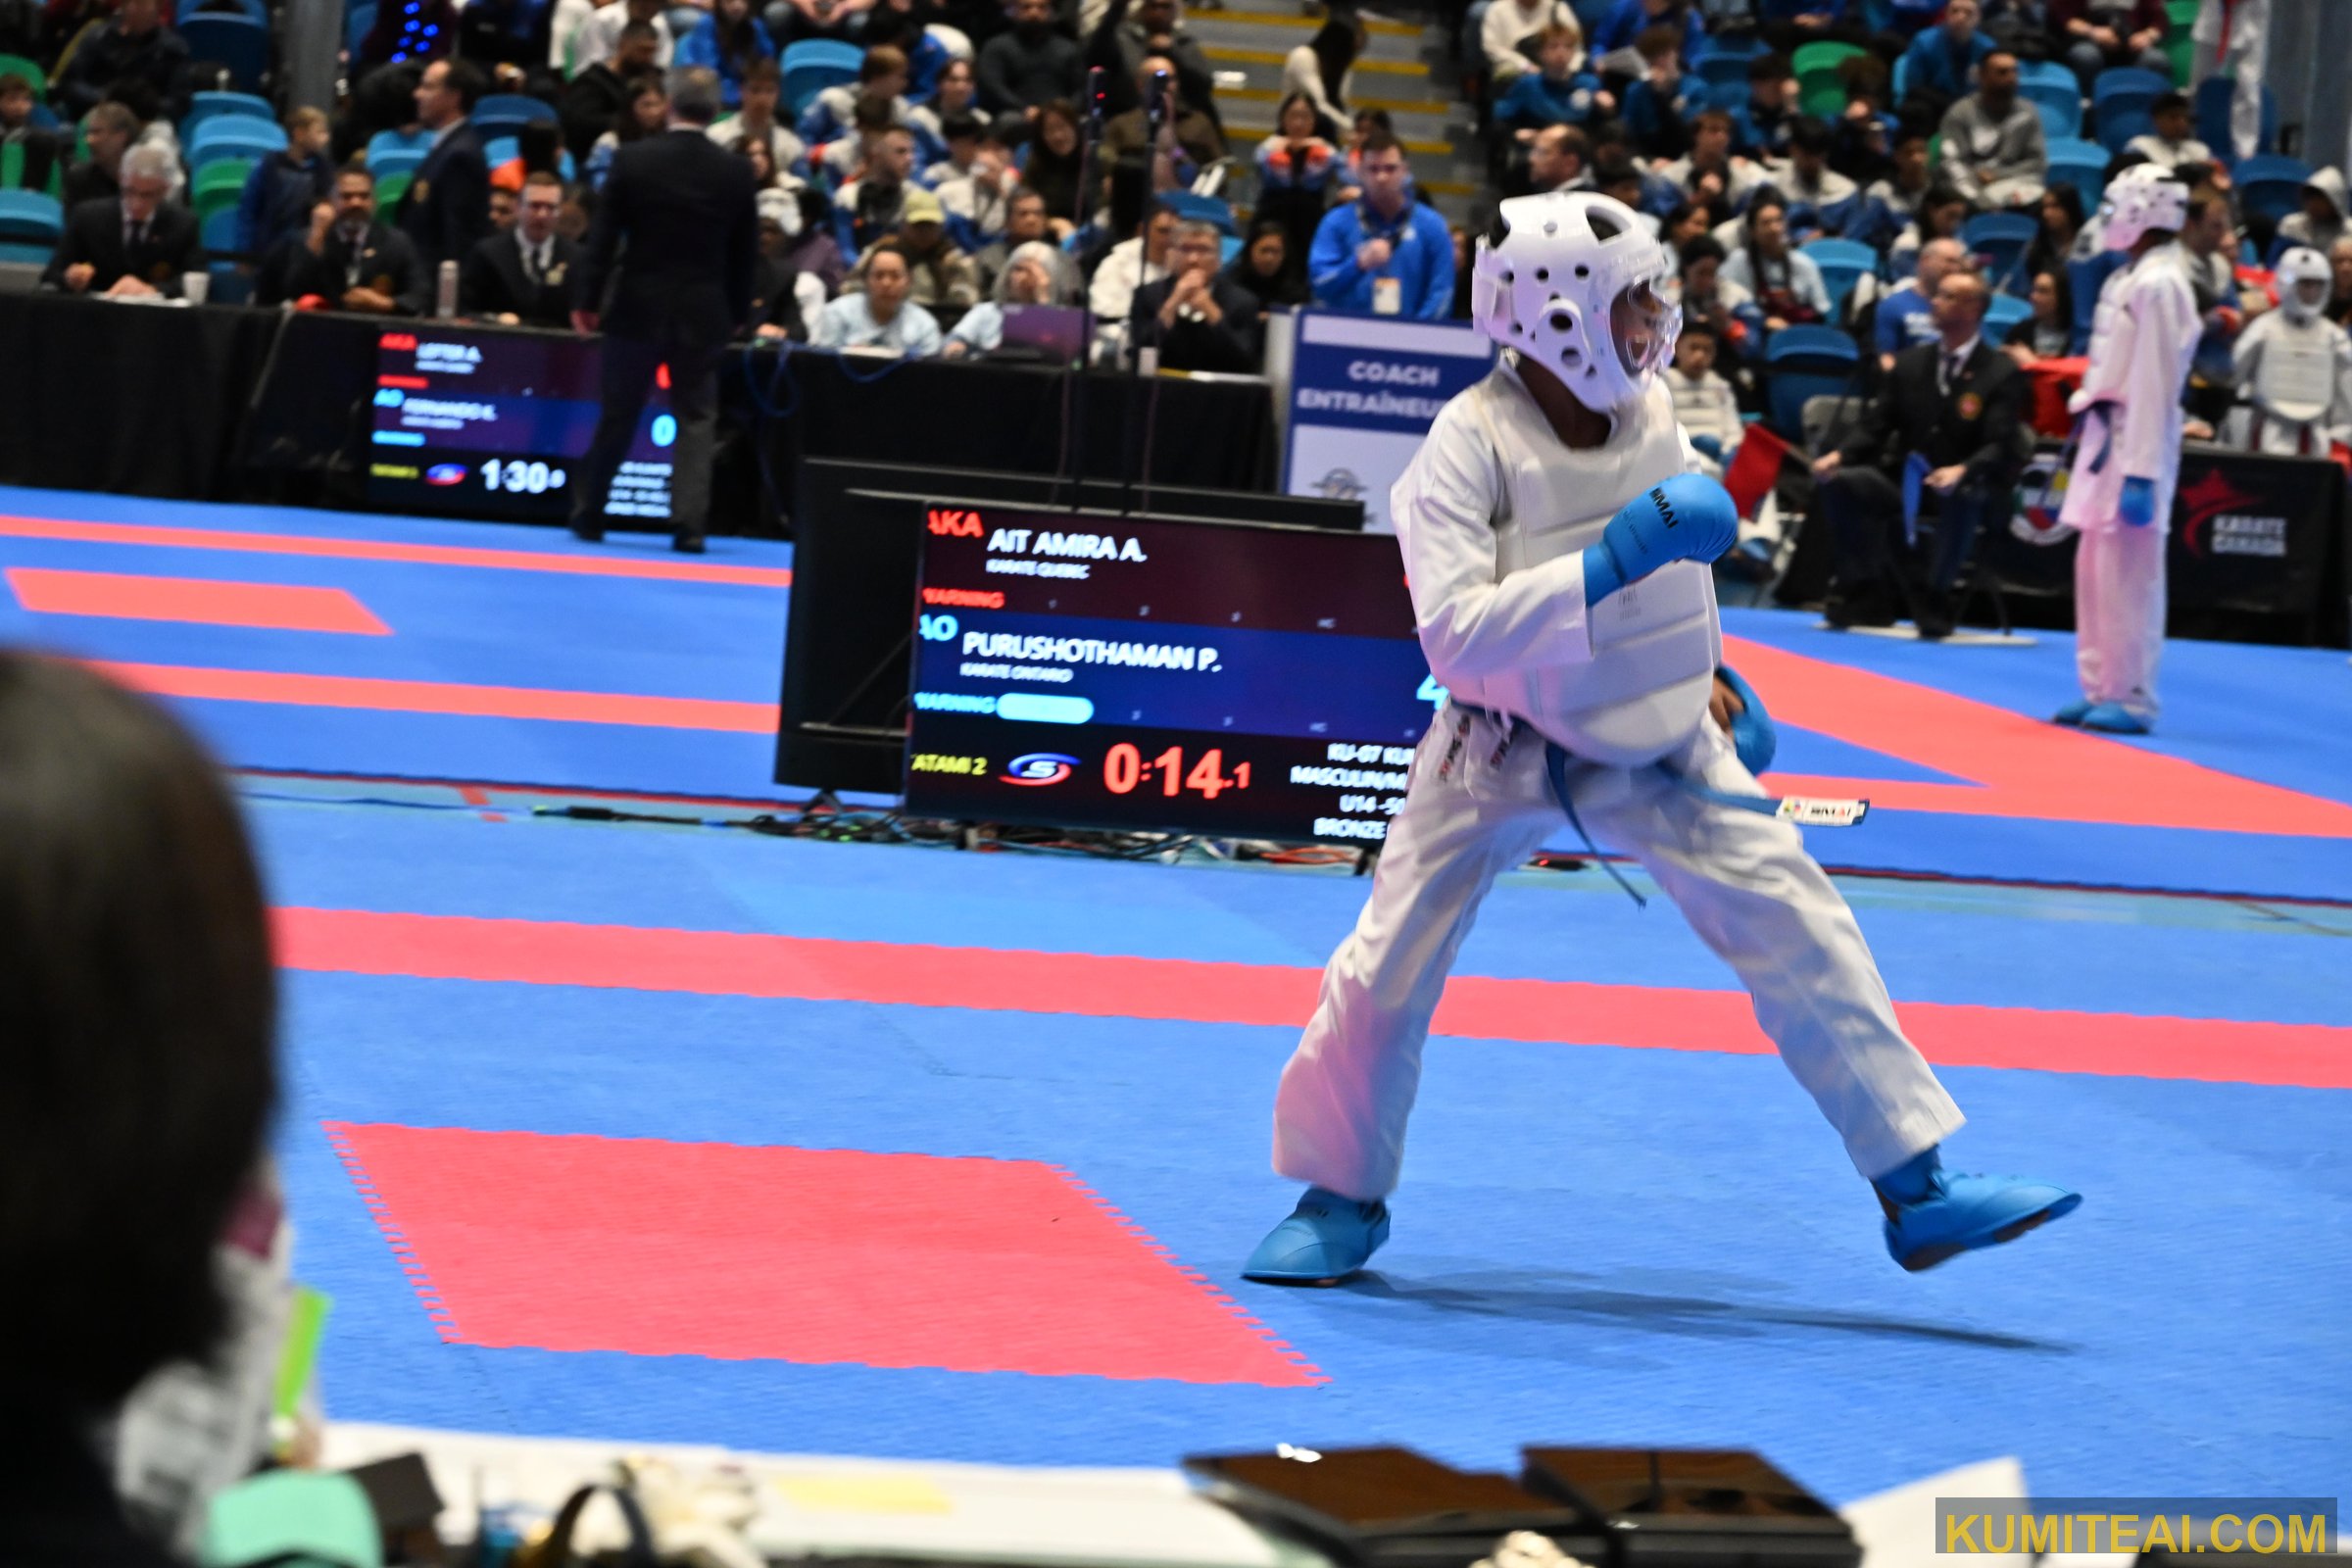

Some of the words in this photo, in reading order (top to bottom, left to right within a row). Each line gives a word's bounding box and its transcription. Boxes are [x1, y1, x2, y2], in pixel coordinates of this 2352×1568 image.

[1347, 360, 1440, 386] COACH
[1296, 388, 1448, 418] ENTRAÎNEU
[987, 527, 1032, 554] AIT
[1032, 531, 1118, 561] AMIRA
[1118, 537, 1148, 563] A.
[962, 631, 1195, 670] PURUSHOTHAMAN
[1198, 647, 1222, 672] P.
[910, 753, 970, 774] ATAMI
[971, 757, 988, 775] 2
[1313, 817, 1387, 839] BRONZE
